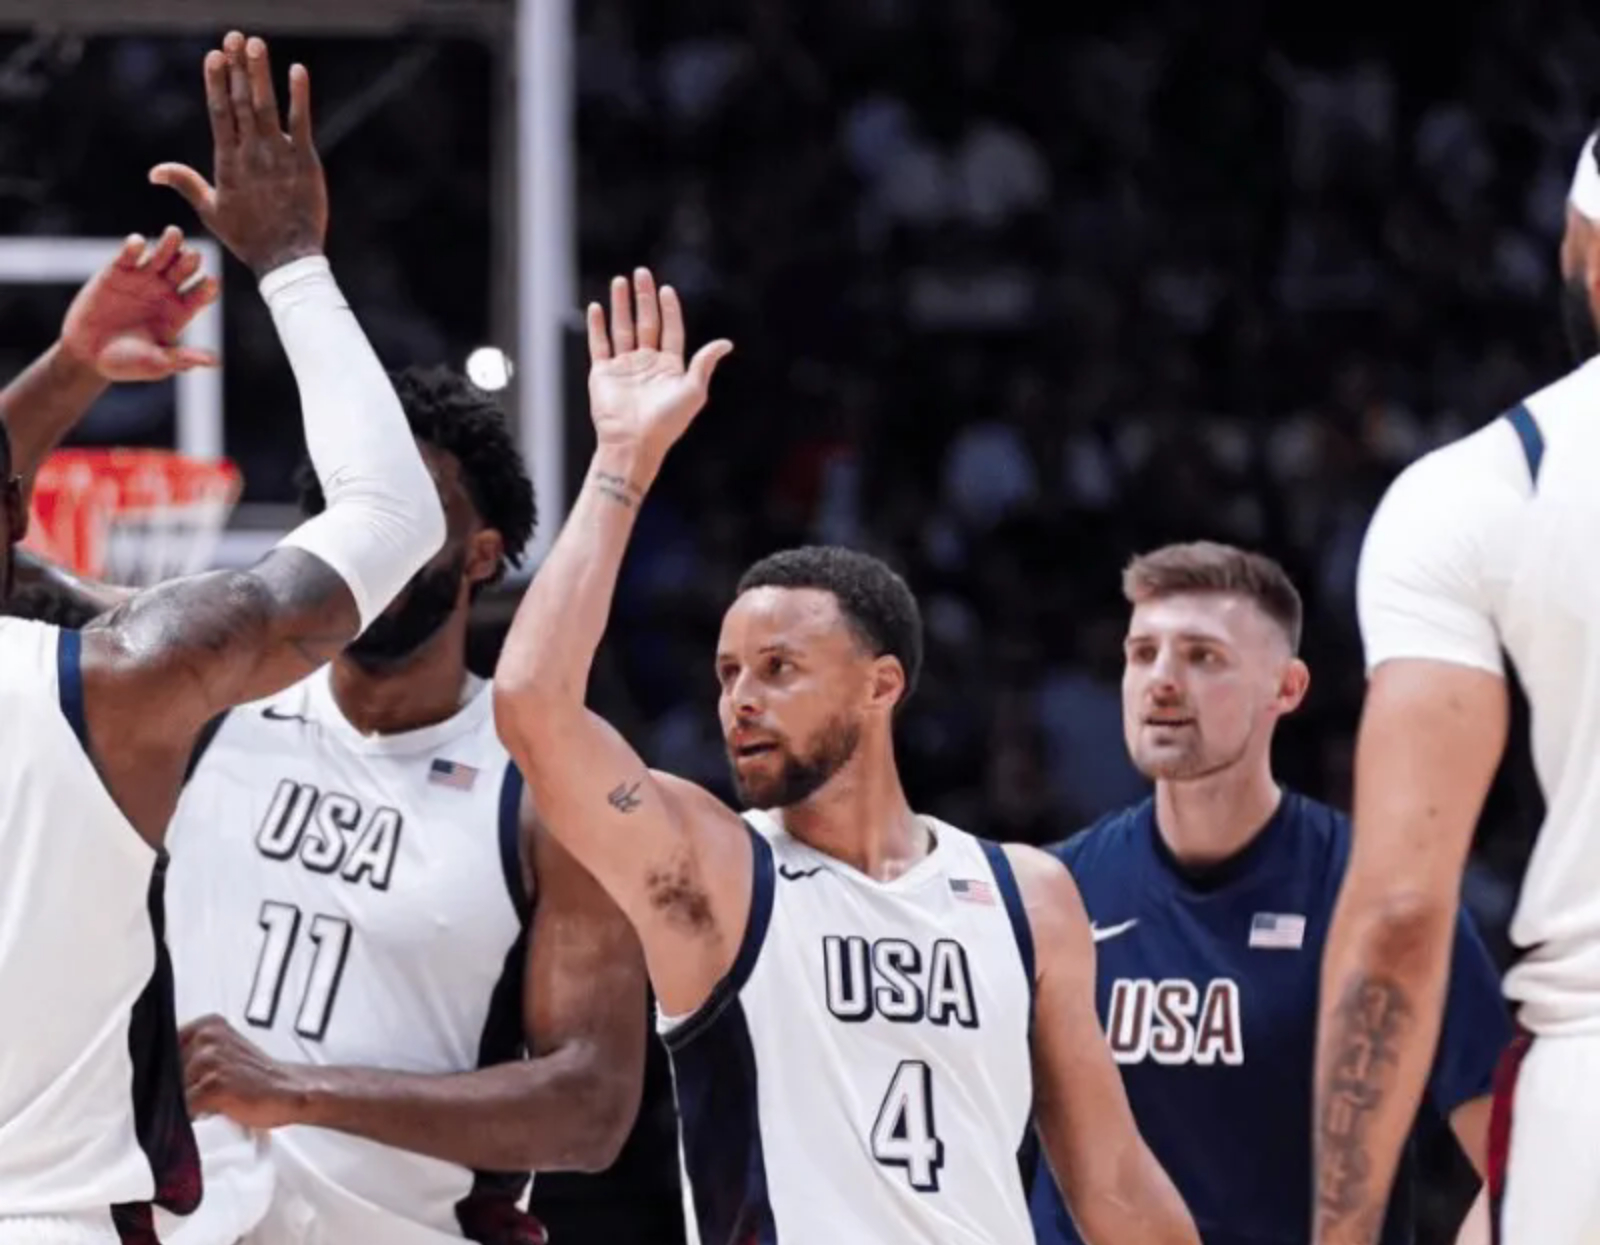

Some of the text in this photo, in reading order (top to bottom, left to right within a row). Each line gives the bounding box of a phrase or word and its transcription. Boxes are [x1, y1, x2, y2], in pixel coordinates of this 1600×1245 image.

[255, 778, 402, 891] USA
[245, 899, 353, 1042] 11
[822, 934, 980, 1029] USA
[1106, 977, 1244, 1066] USA
[870, 1059, 945, 1193] 4
